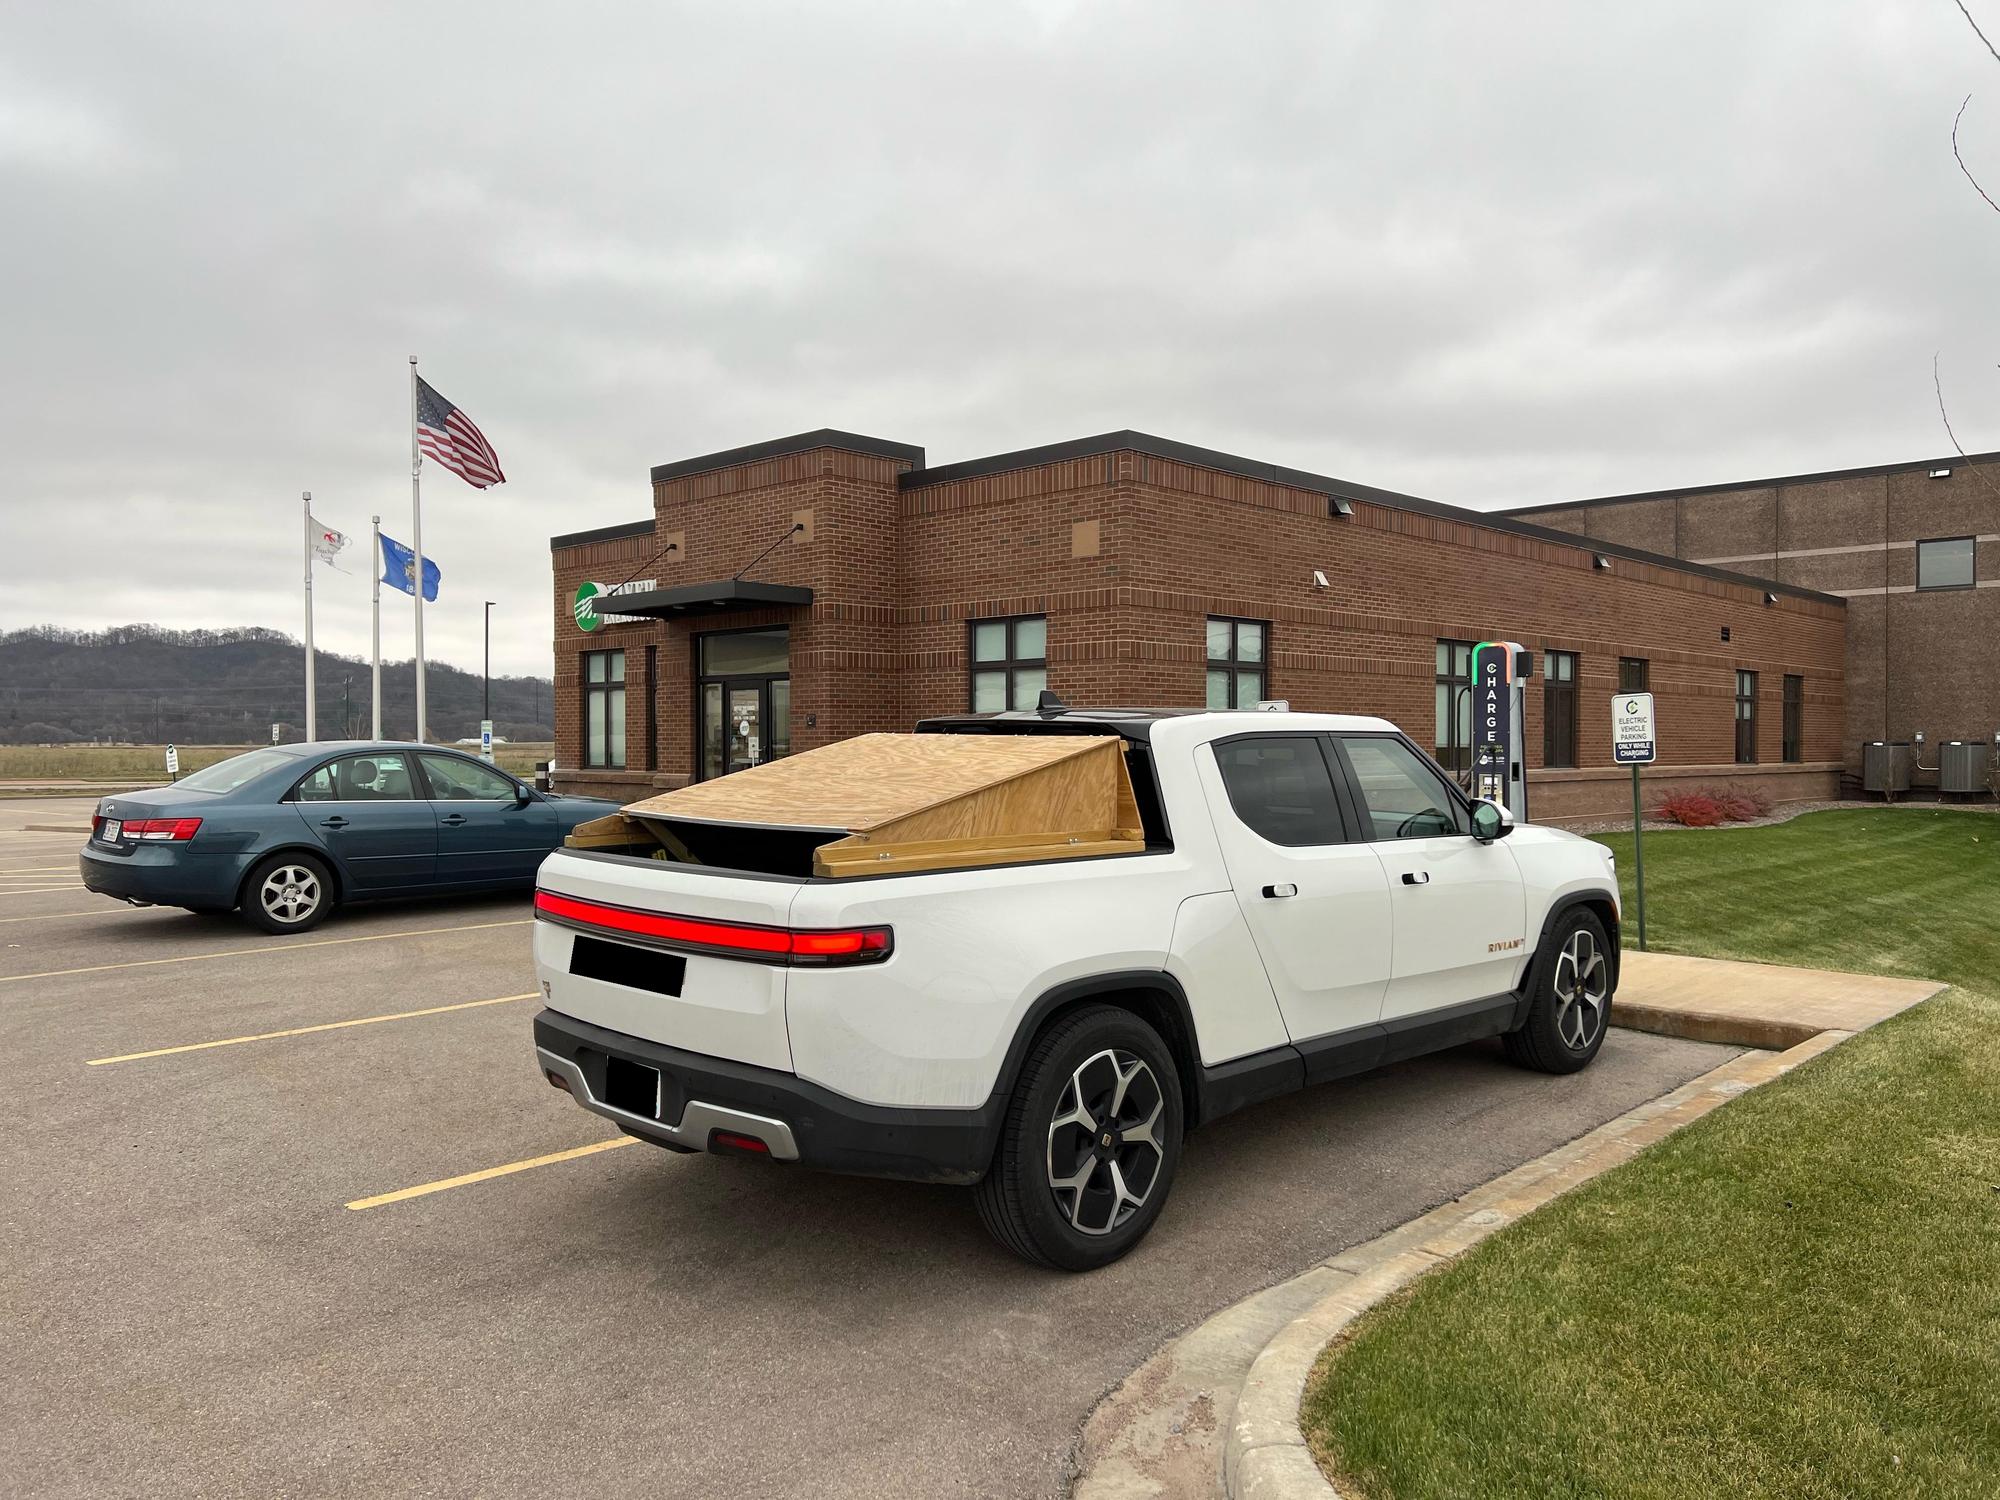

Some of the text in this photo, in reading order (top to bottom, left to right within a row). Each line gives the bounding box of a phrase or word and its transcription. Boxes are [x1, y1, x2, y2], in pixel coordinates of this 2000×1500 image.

[1486, 662, 1498, 742] CHARGE
[1618, 716, 1647, 725] ELECTRIC
[1488, 939, 1519, 953] RIVIAN
